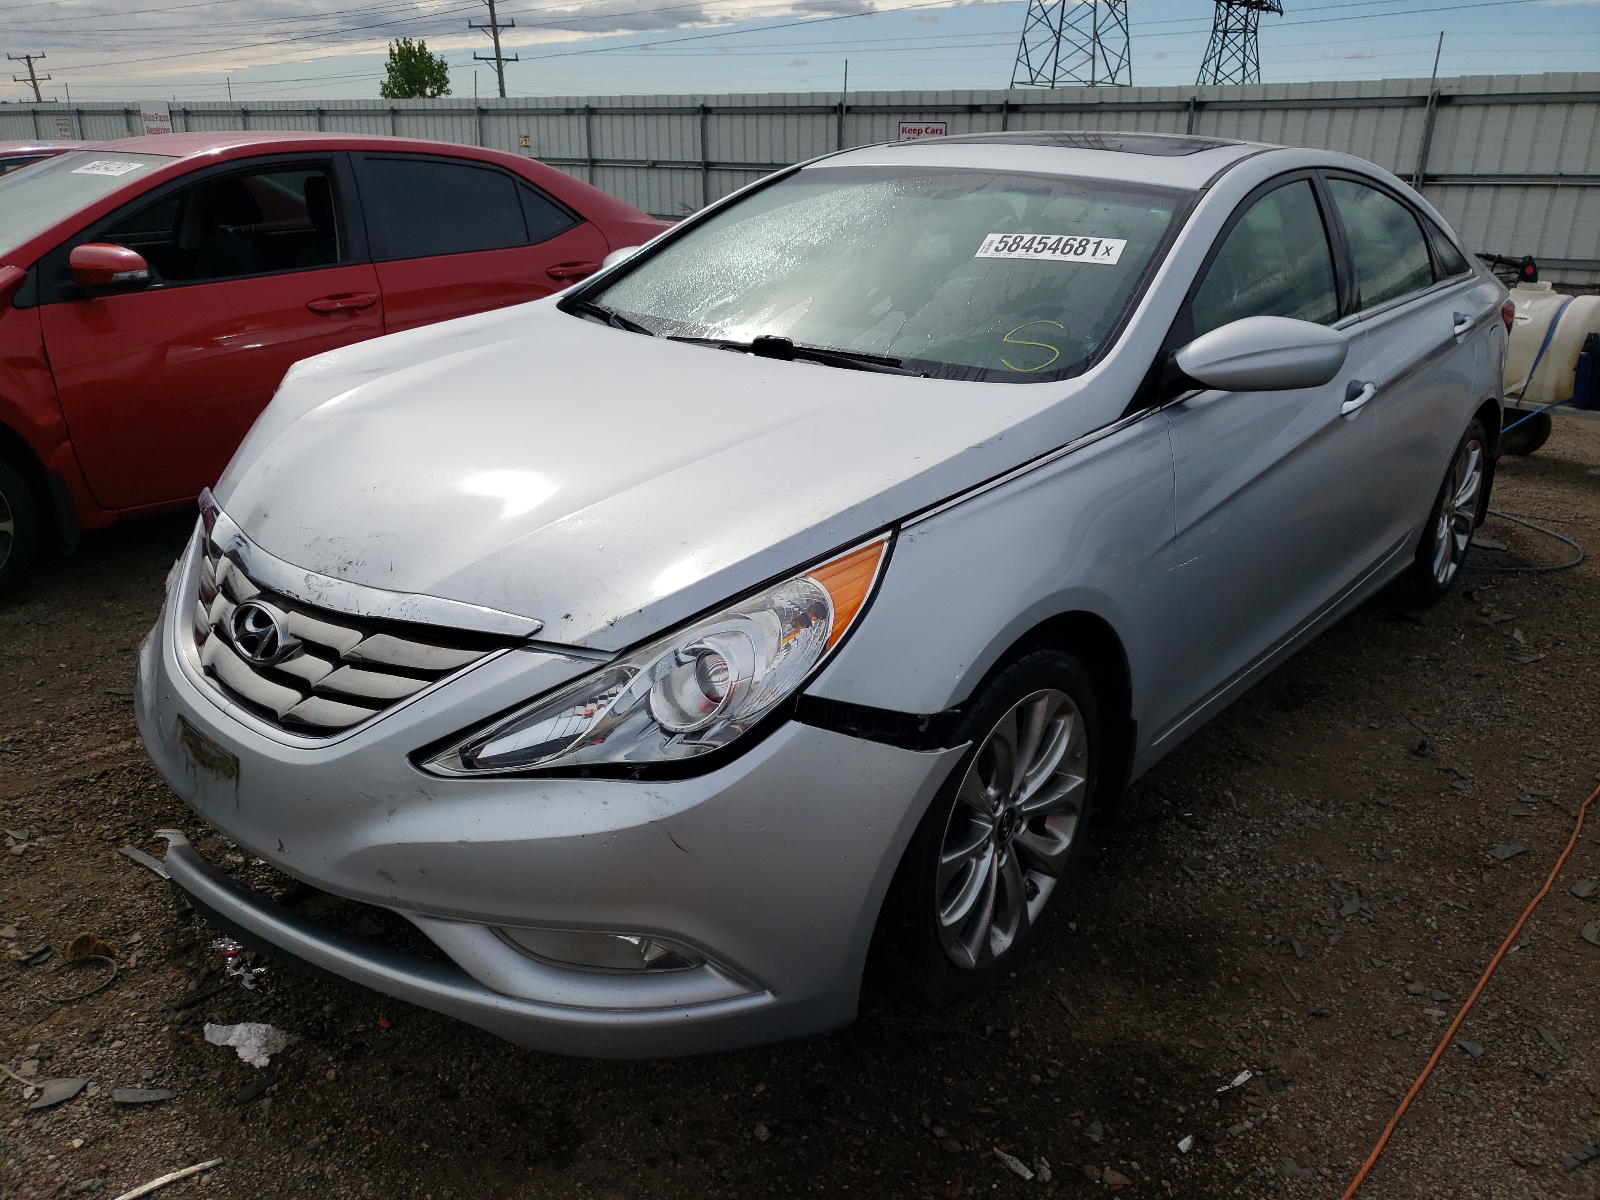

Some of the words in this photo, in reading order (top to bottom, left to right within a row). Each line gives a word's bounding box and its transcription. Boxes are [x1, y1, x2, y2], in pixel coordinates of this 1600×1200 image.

[901, 126, 923, 136] Keep
[925, 127, 943, 135] Cars
[1000, 319, 1064, 373] S
